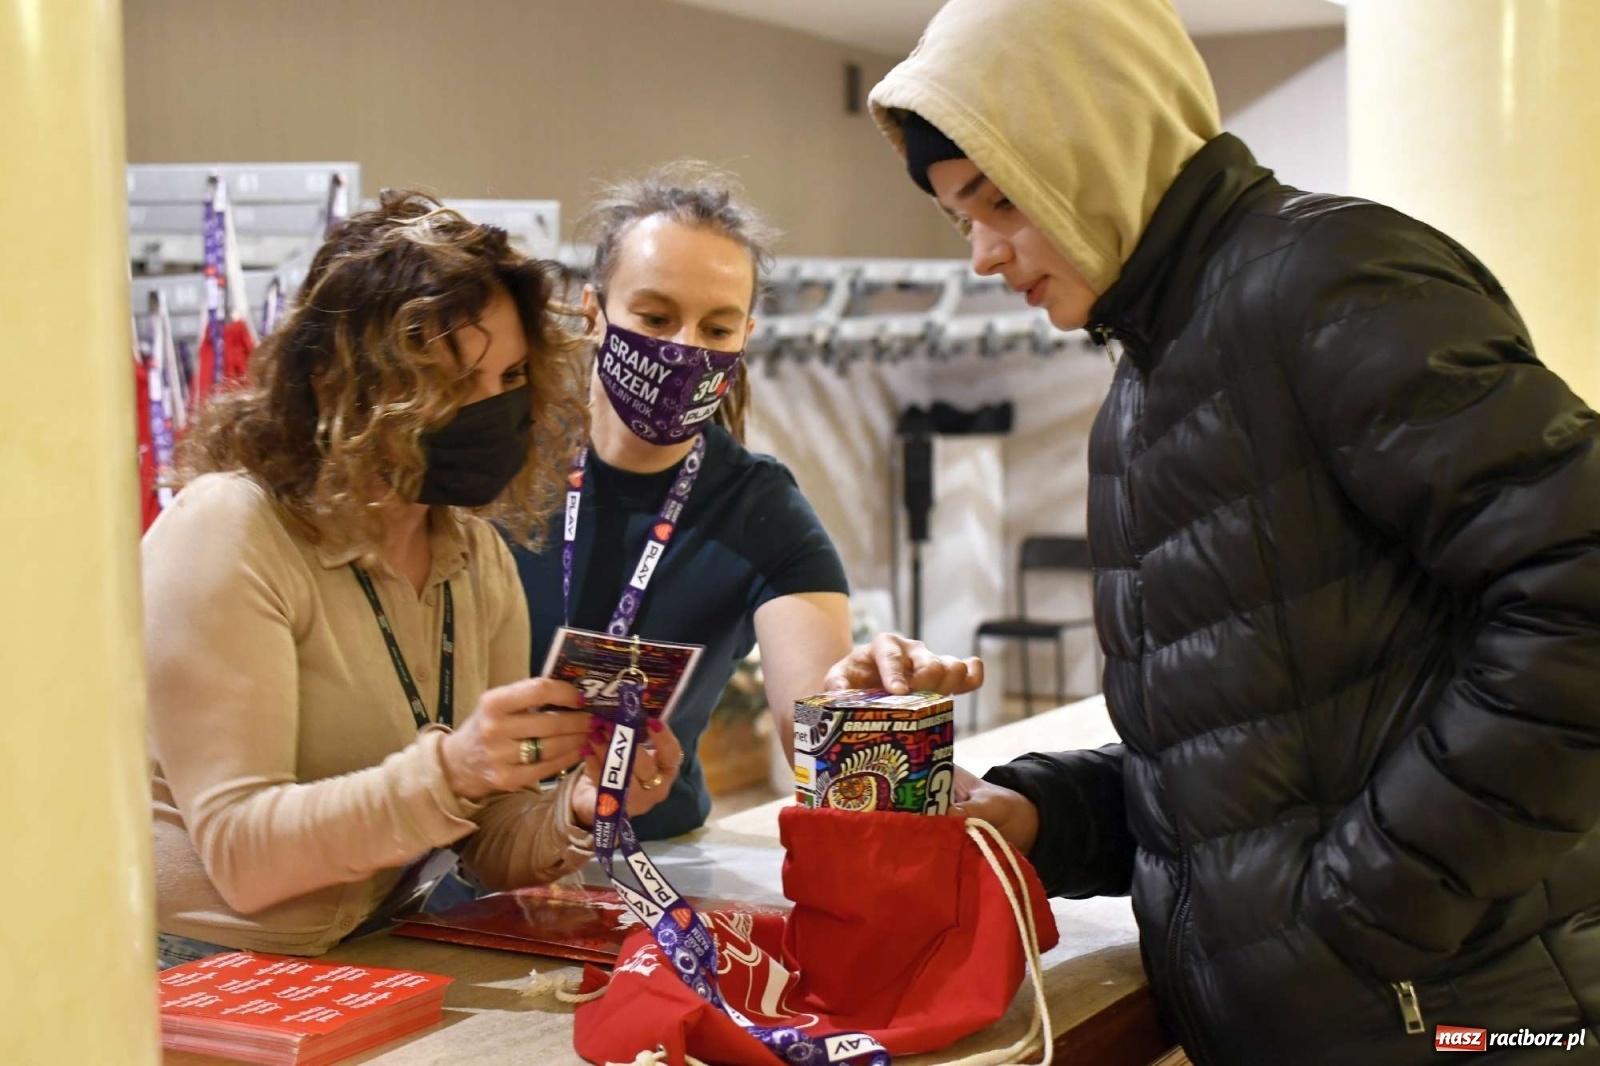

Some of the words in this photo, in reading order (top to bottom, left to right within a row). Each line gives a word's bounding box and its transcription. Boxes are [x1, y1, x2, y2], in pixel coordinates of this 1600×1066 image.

[602, 352, 660, 405] RAZEM
[610, 334, 672, 385] GRAMY
[693, 371, 725, 402] 30
[567, 495, 577, 536] PLAY
[637, 545, 659, 585] PLAY
[843, 721, 891, 732] GRAMY
[892, 721, 918, 732] DLA
[607, 731, 628, 785] PLAY
[634, 859, 672, 903] PLAY
